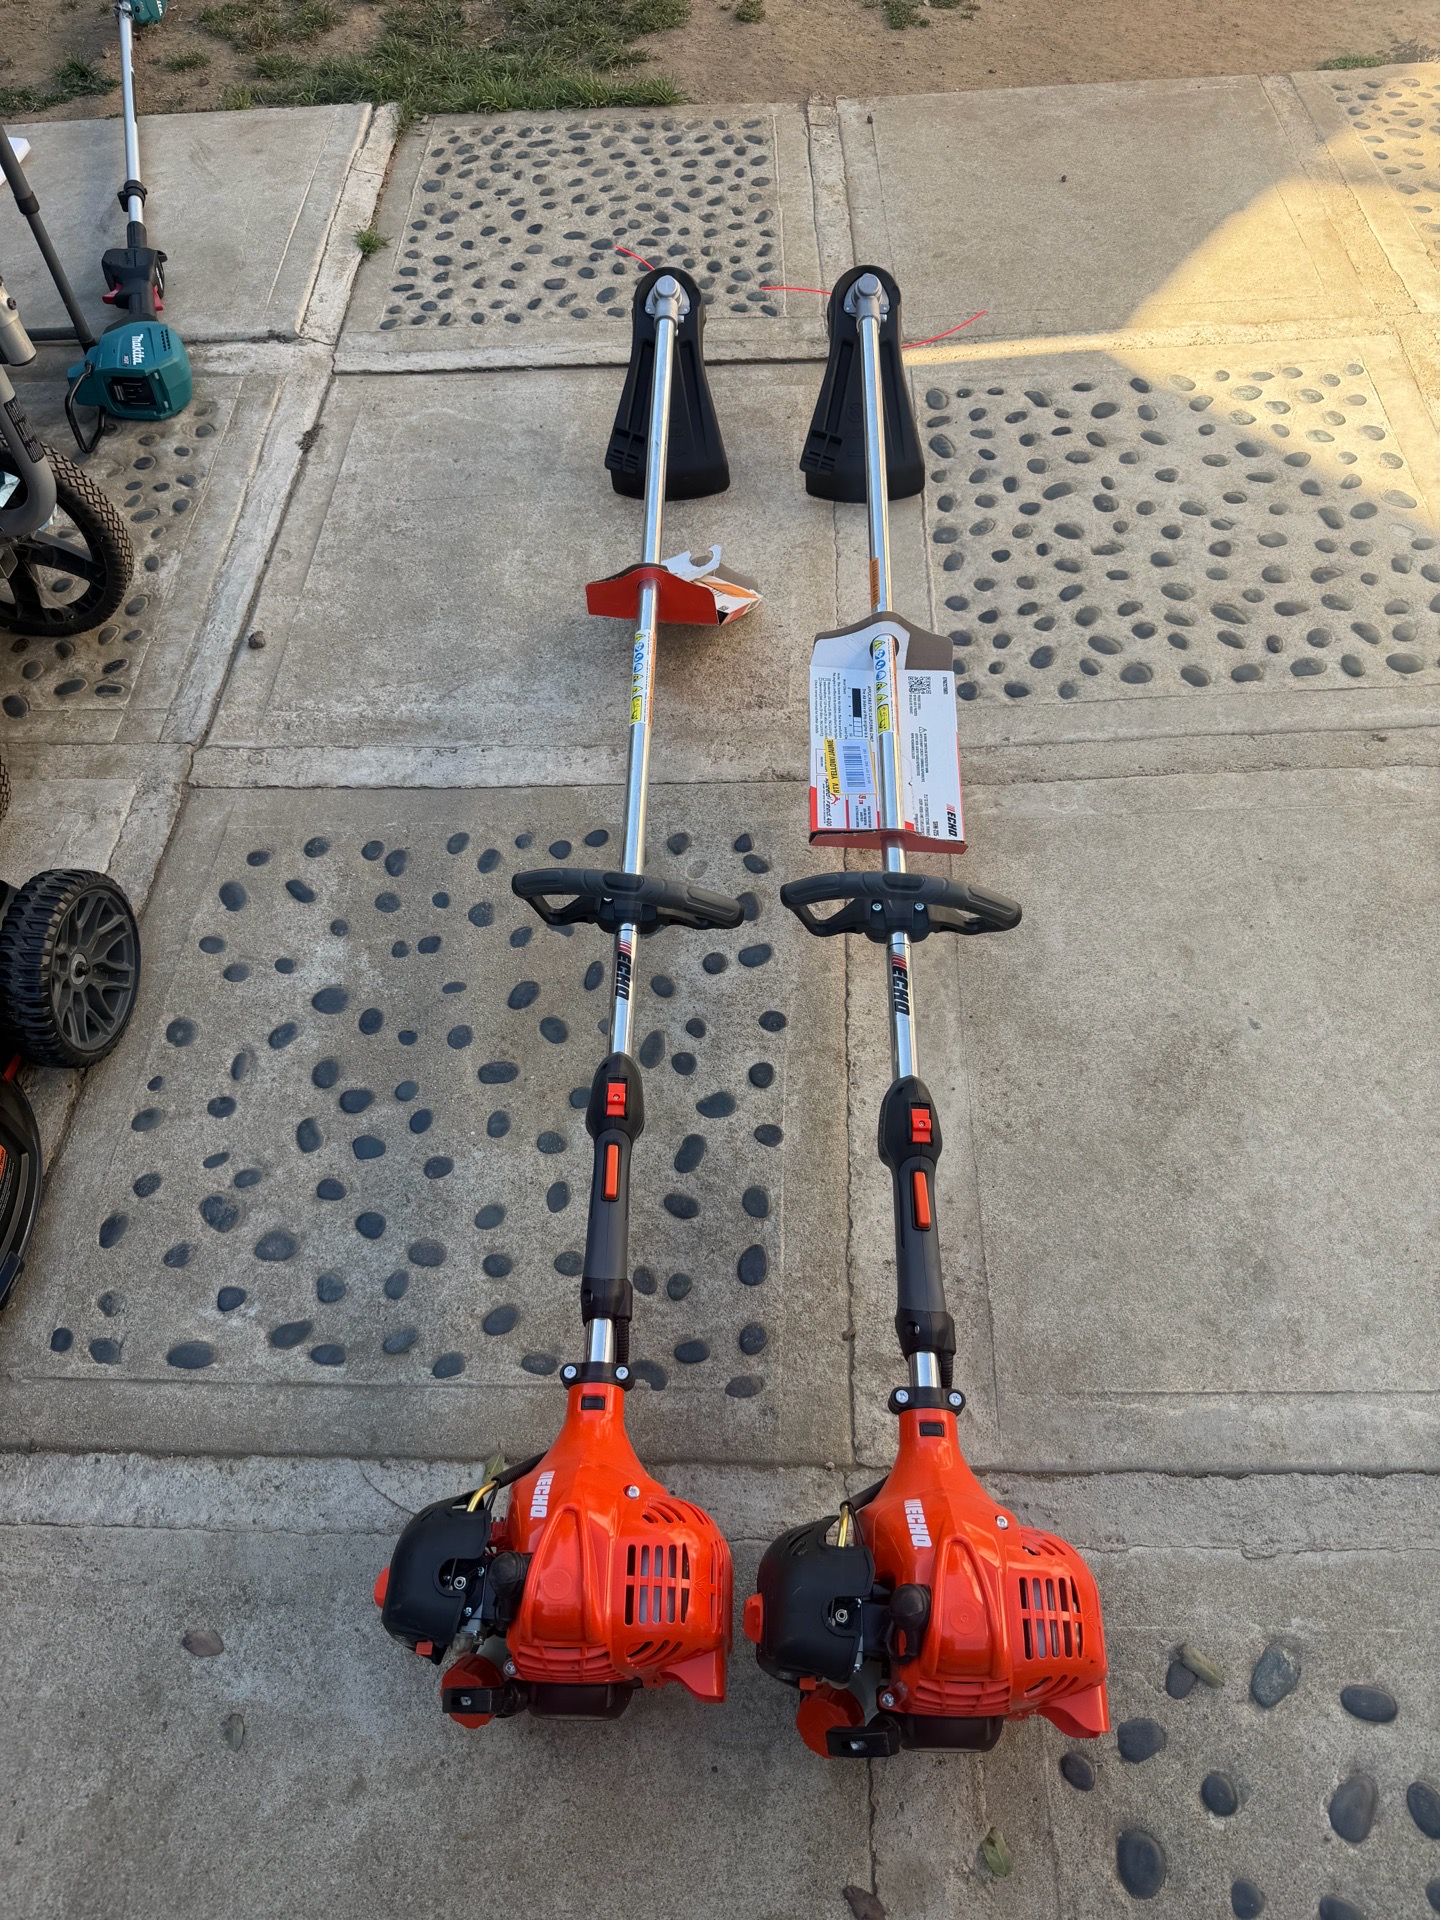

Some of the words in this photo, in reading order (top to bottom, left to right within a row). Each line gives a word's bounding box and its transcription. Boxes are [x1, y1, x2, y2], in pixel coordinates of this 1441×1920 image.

[946, 810, 958, 837] ECHO
[615, 950, 632, 1001] ECHO
[891, 964, 911, 1016] ECHO
[530, 1475, 555, 1519] ECHO
[905, 1504, 932, 1549] ECHO
